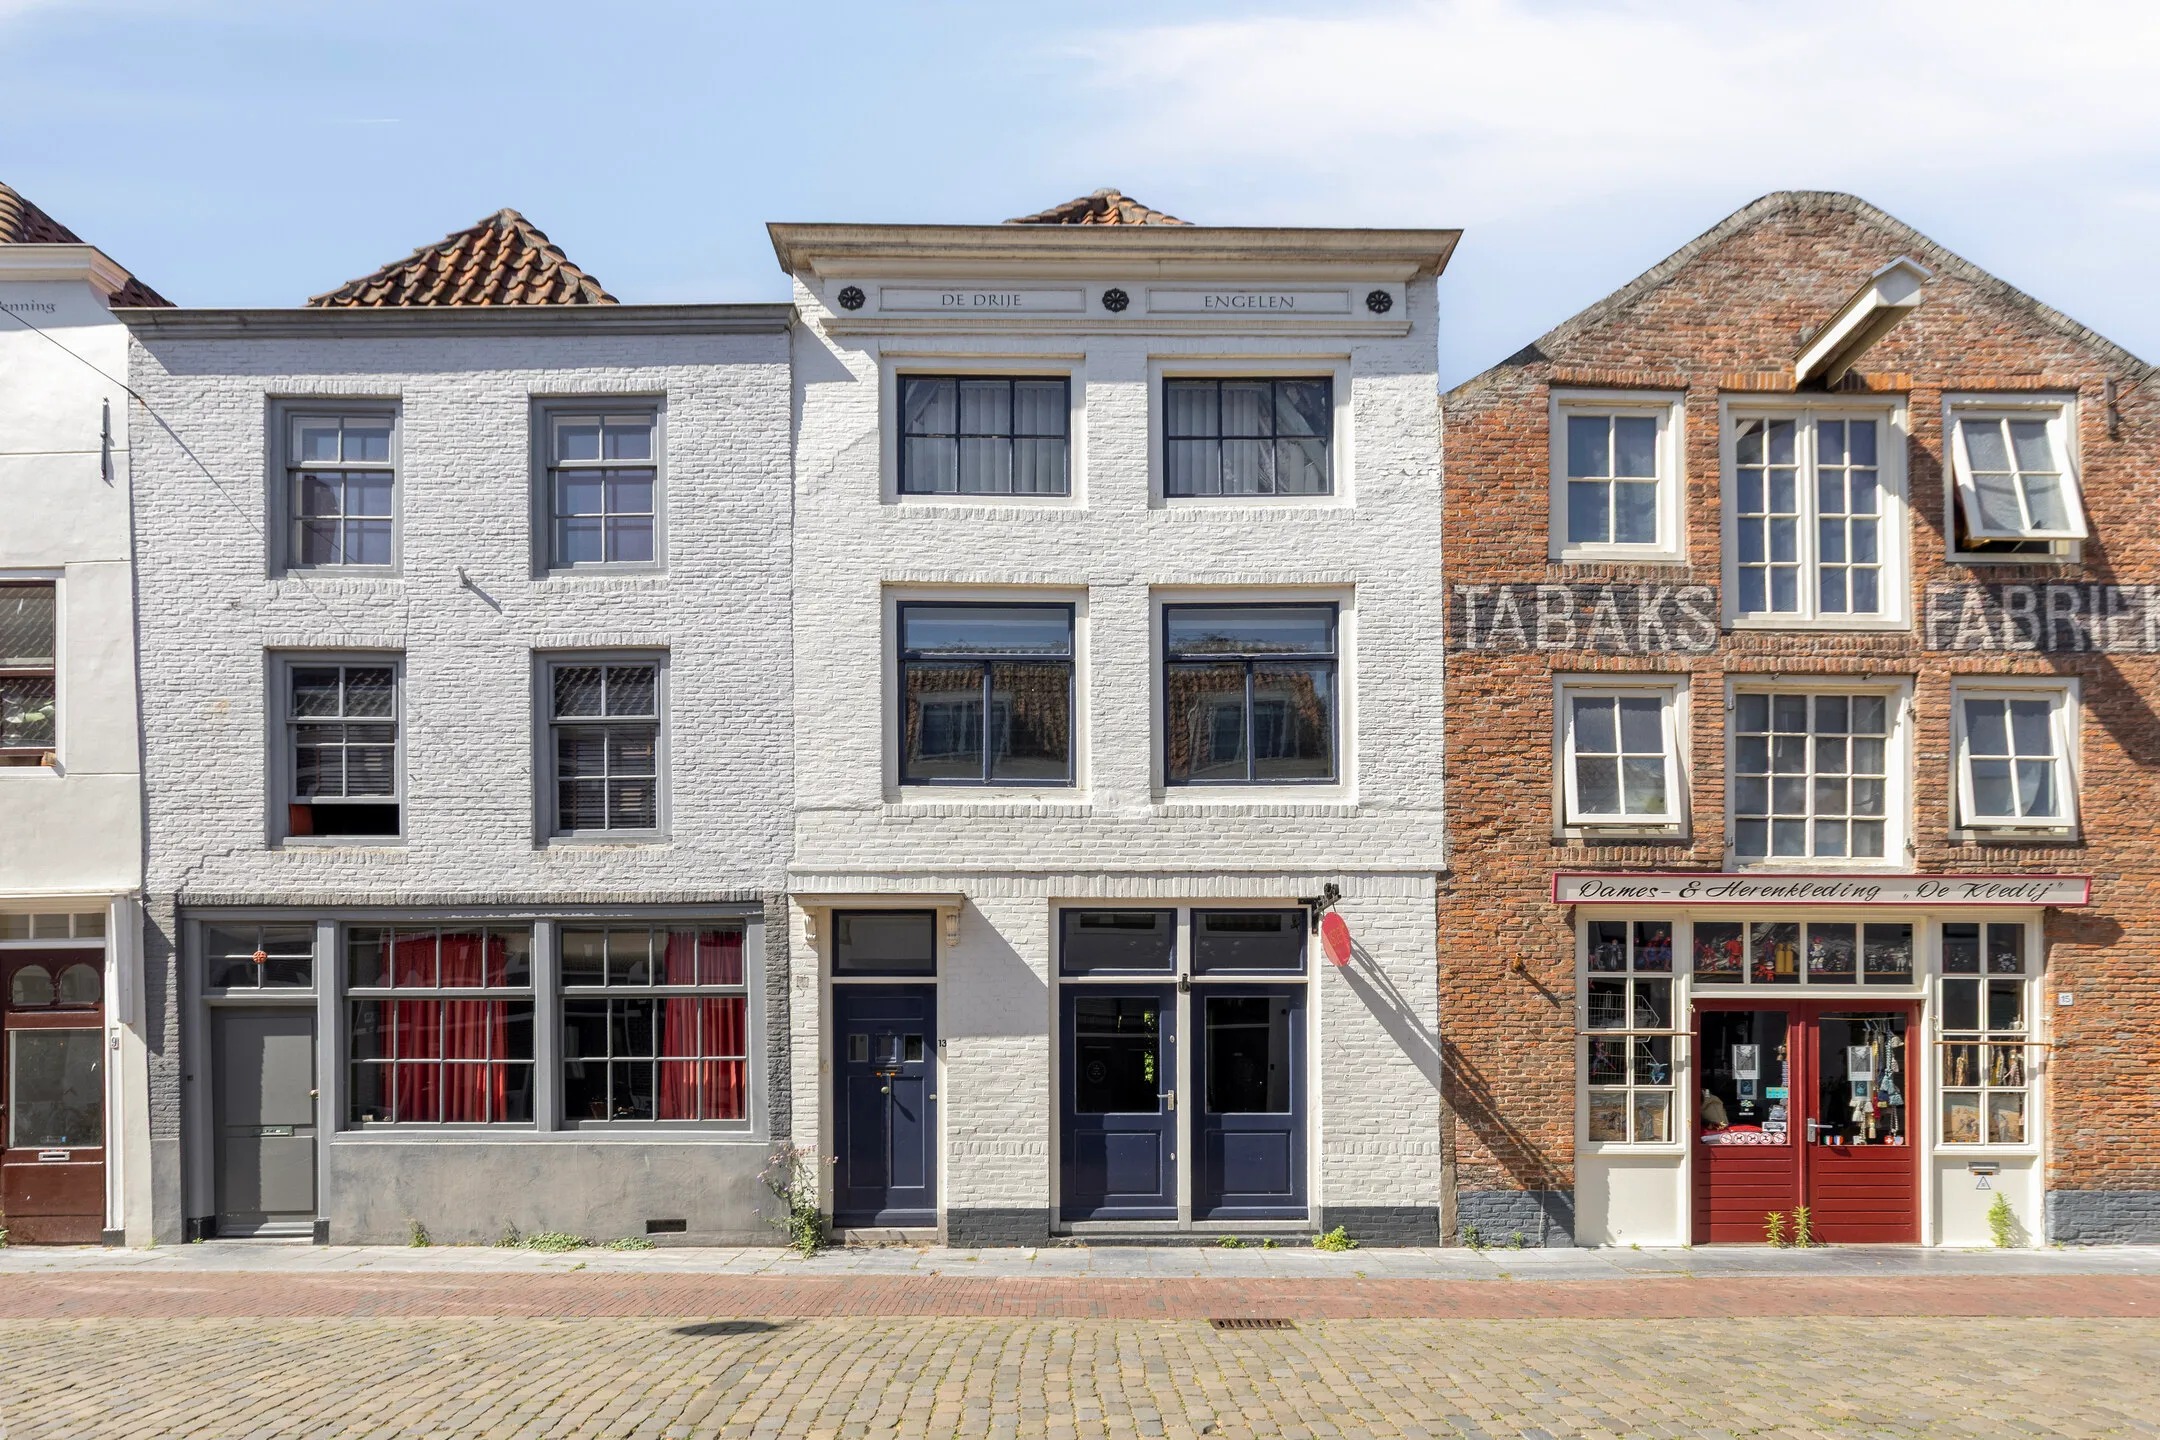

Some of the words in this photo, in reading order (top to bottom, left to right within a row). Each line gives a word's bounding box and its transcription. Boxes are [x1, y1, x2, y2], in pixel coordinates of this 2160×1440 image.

[0, 299, 56, 314] enning
[942, 294, 966, 306] DE
[973, 294, 1022, 307] DRIJE
[1204, 295, 1294, 309] ENGELEN
[1454, 584, 1717, 651] TABAKS
[1578, 879, 1671, 898] Dames-
[1679, 880, 1702, 899] &
[1705, 880, 1882, 902] Herenkleding
[2060, 995, 2072, 1003] 15
[938, 1039, 947, 1048] 13
